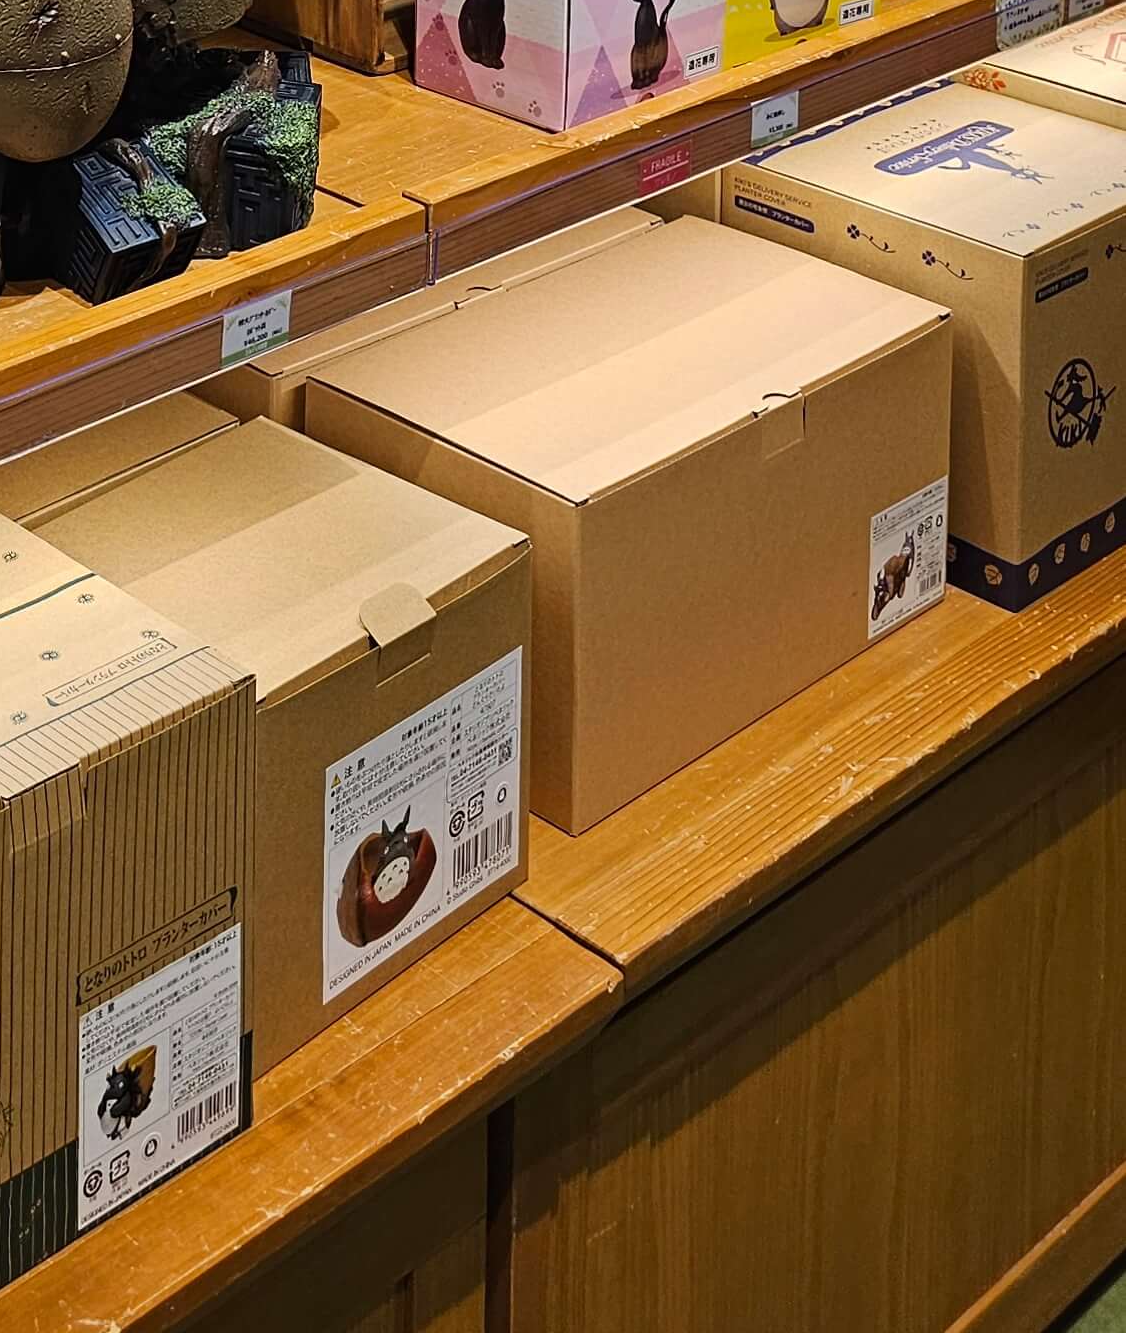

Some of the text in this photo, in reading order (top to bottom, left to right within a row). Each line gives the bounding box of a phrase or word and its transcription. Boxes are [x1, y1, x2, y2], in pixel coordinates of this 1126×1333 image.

[84, 904, 227, 993] となりのトトロ プランターカバー
[329, 959, 363, 990] DESIGNED
[371, 940, 392, 959] JAPAN
[394, 925, 413, 943] MADE
[422, 904, 441, 926] CHINA
